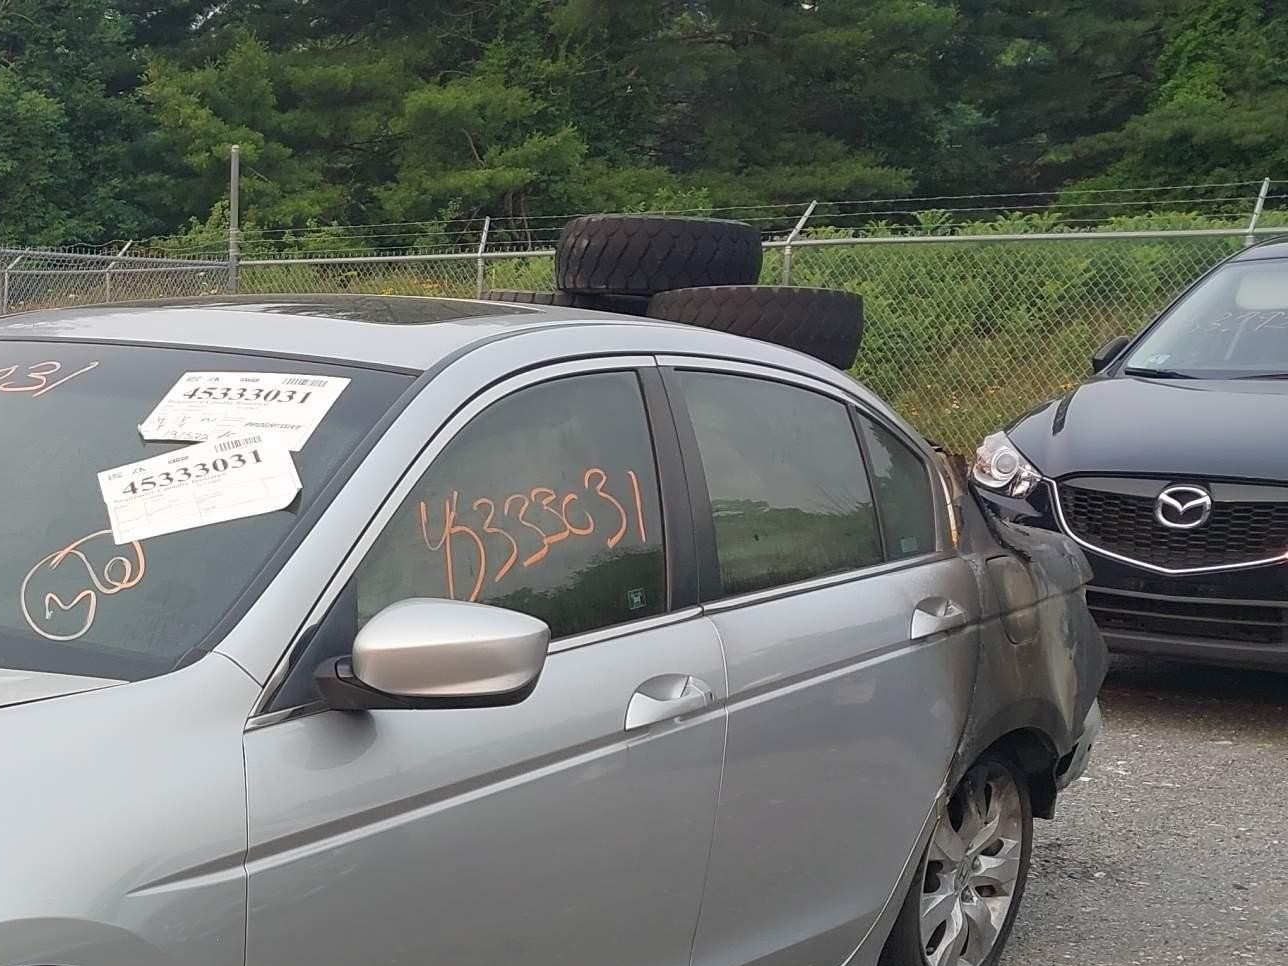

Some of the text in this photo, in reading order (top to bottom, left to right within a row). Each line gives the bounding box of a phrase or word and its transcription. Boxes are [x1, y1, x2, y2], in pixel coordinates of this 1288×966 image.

[183, 387, 312, 404] 45333031
[123, 449, 263, 495] 45333031
[420, 467, 647, 602] 45333031
